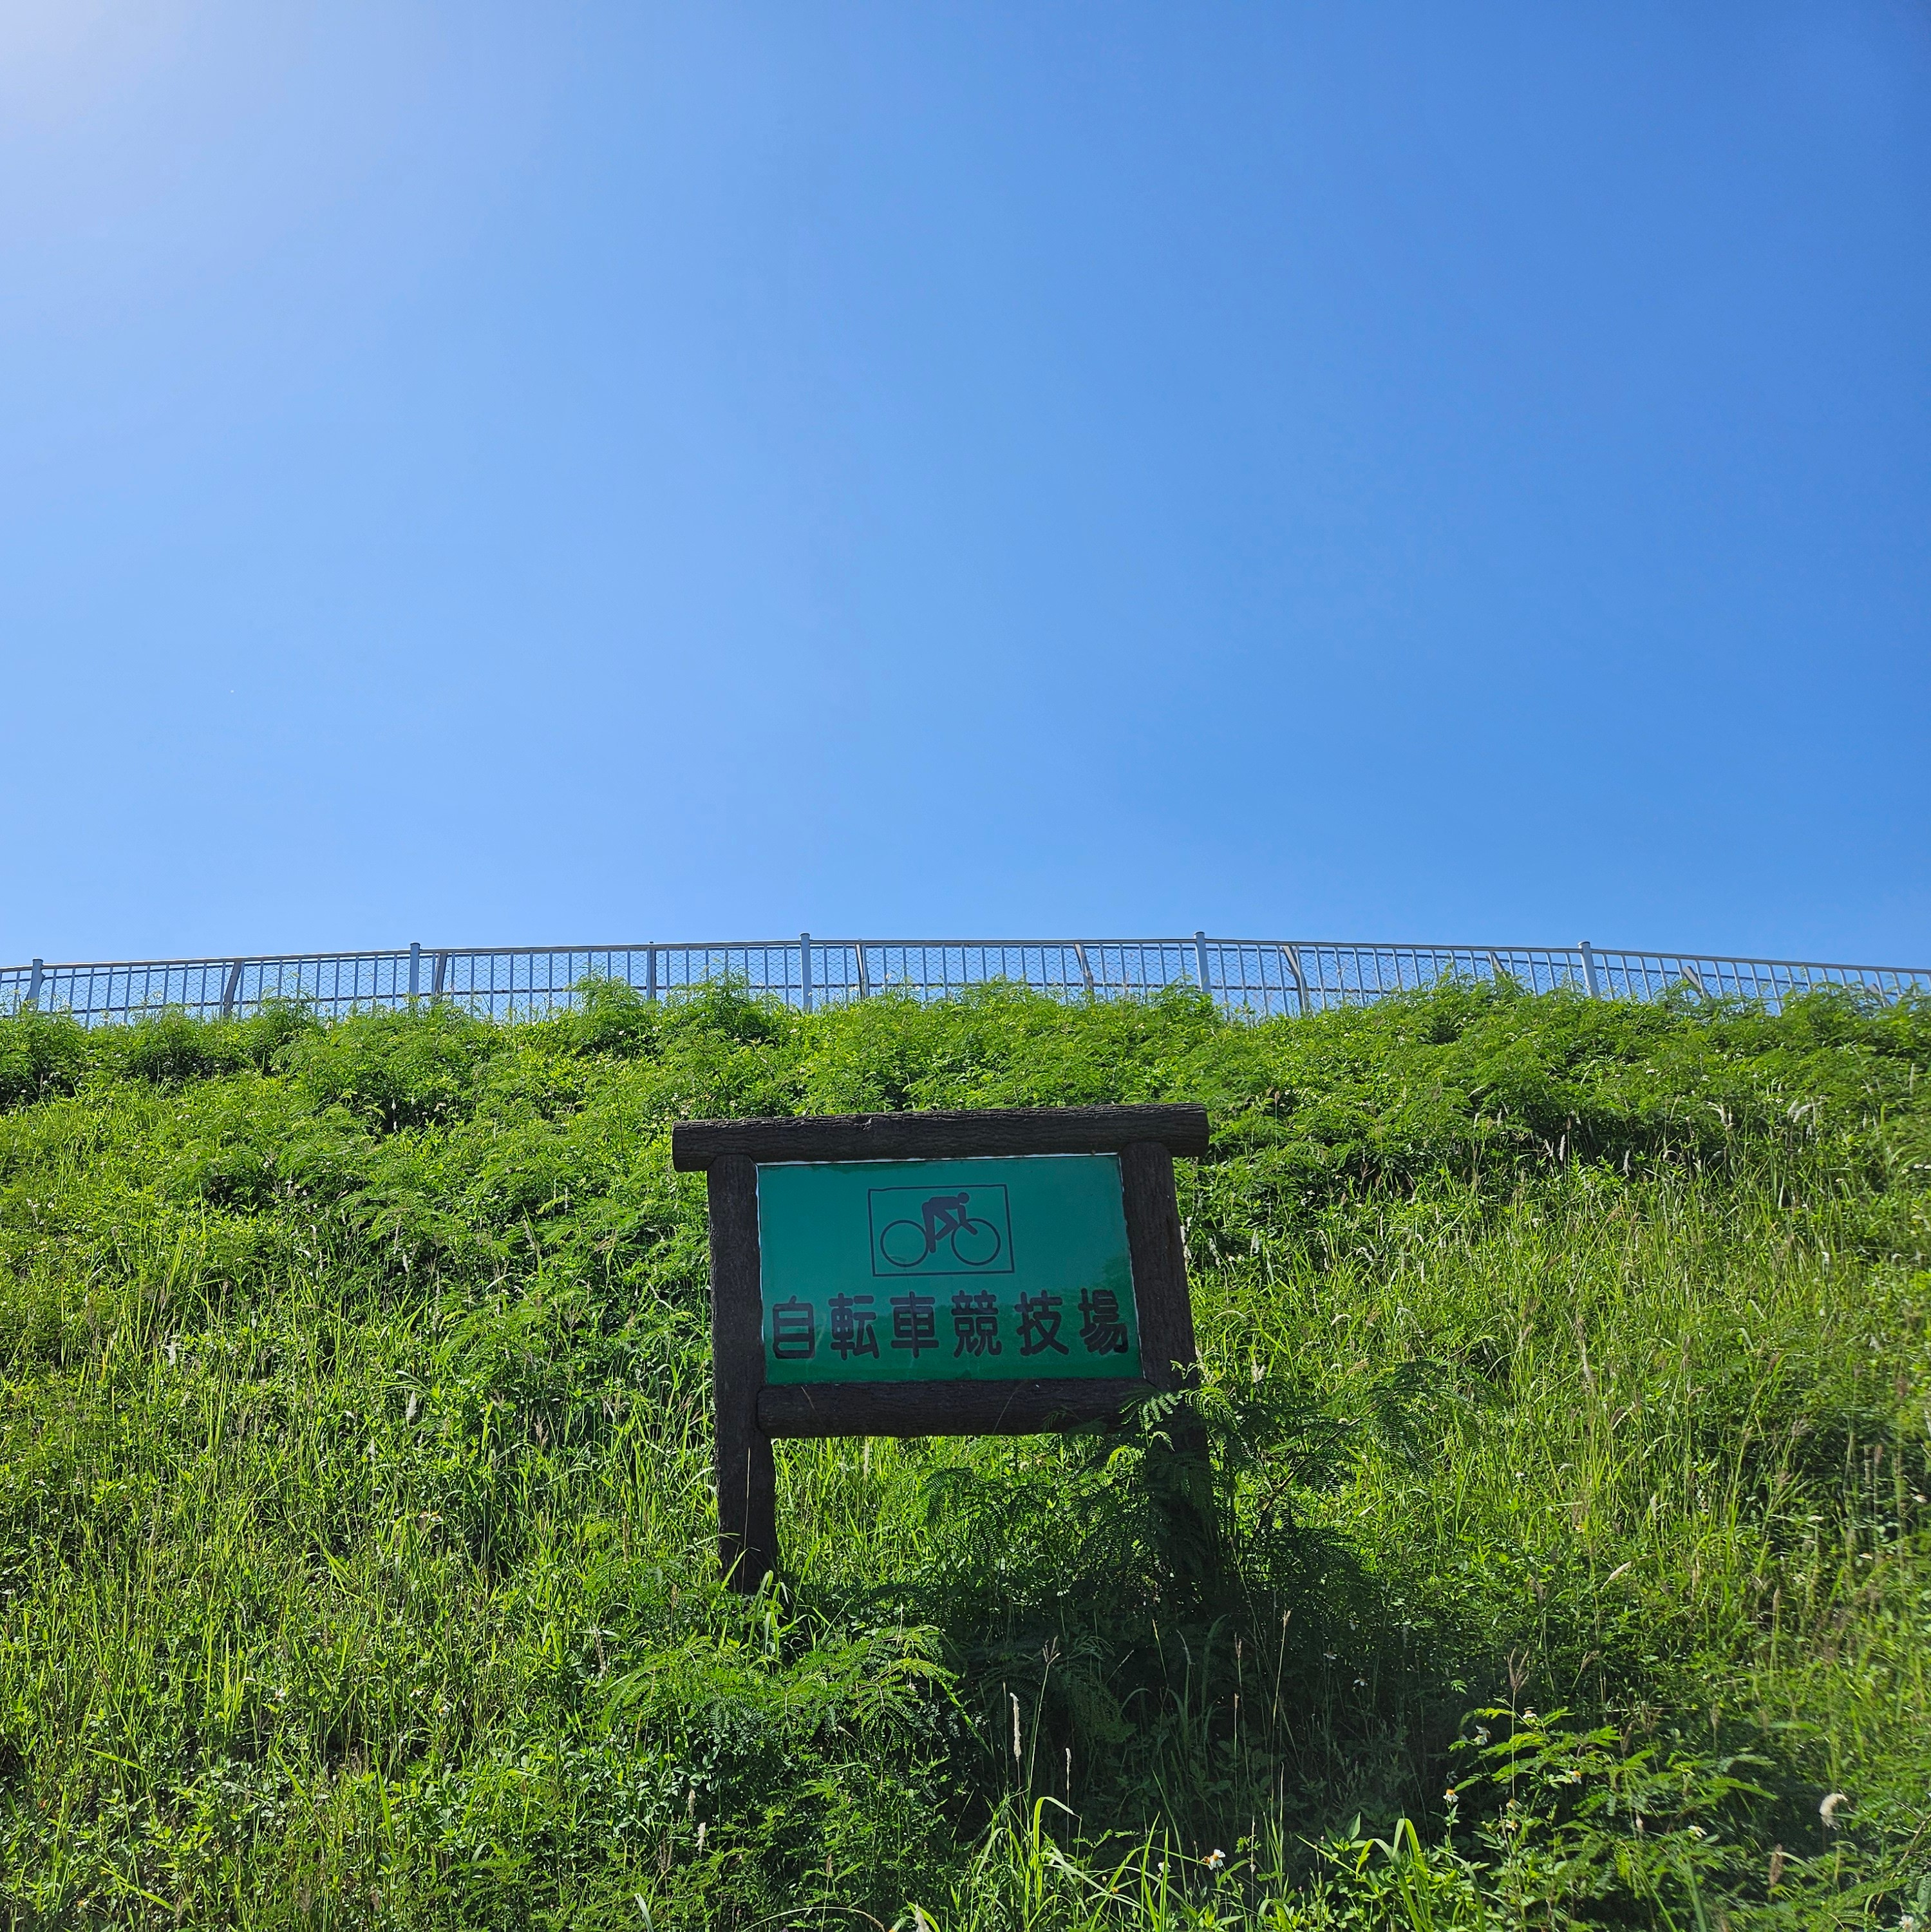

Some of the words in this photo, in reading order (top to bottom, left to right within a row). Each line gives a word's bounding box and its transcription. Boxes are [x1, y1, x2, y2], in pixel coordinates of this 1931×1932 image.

[773, 1289, 1129, 1360] 自転車競技場
